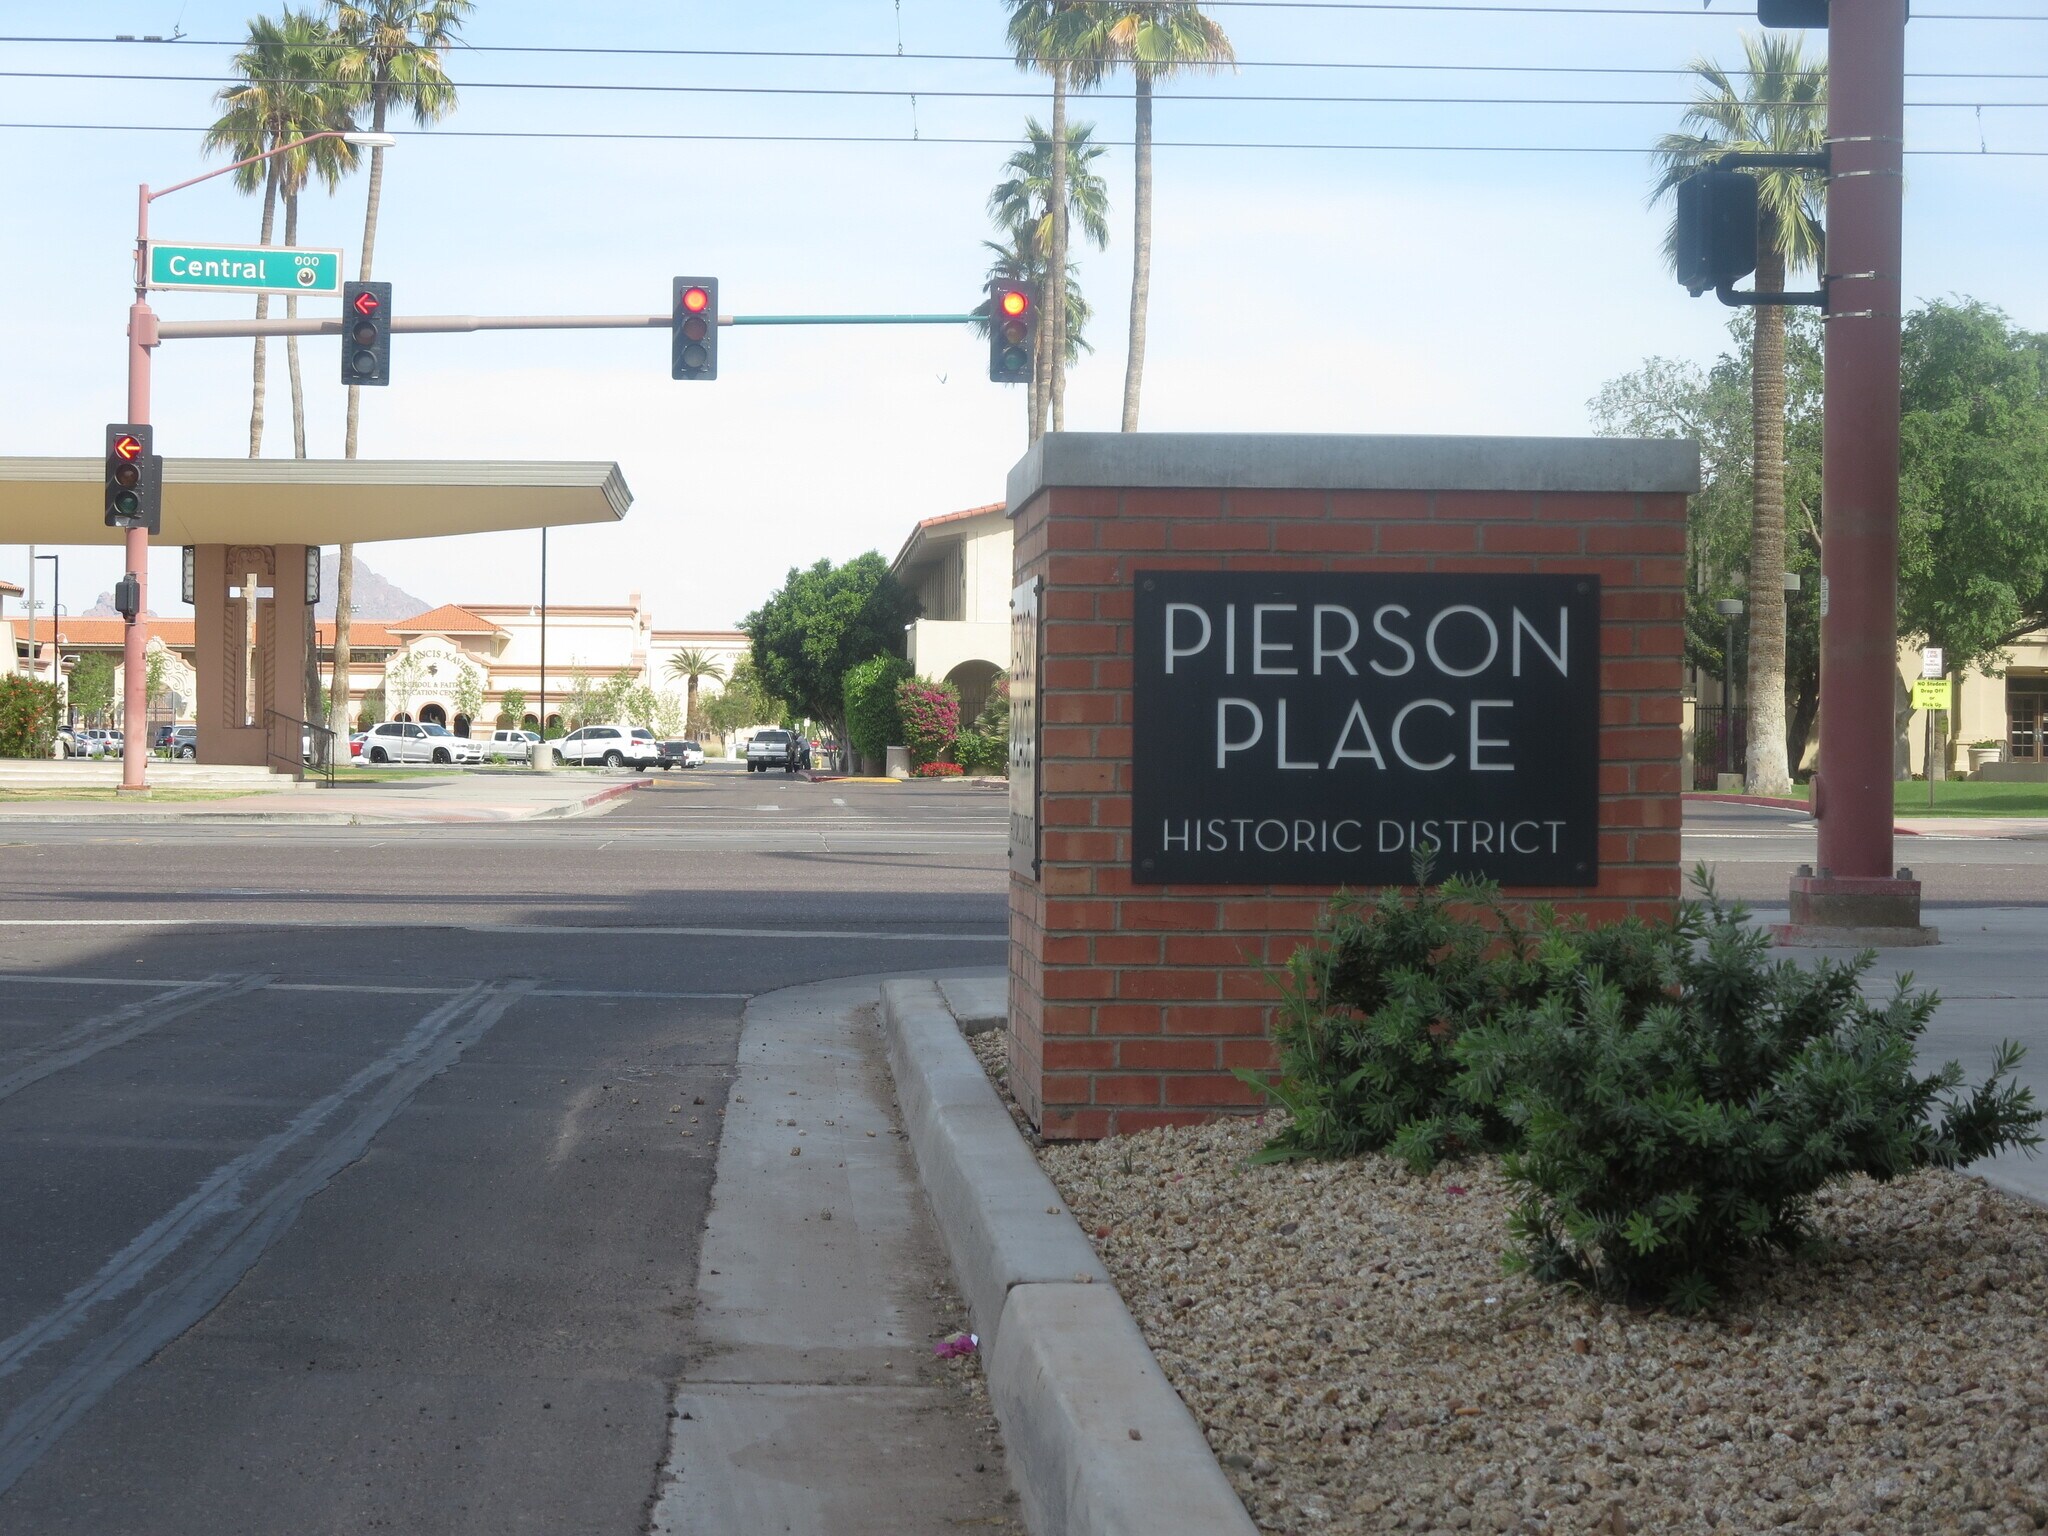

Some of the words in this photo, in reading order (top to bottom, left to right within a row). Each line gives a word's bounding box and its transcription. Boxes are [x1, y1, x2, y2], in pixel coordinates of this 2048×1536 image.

[169, 255, 266, 280] Central
[294, 256, 320, 267] 000
[1164, 602, 1569, 678] PIERSON
[1216, 697, 1515, 772] PLACE
[1163, 818, 1362, 853] HISTORIC
[1378, 820, 1567, 854] DISTRICT
